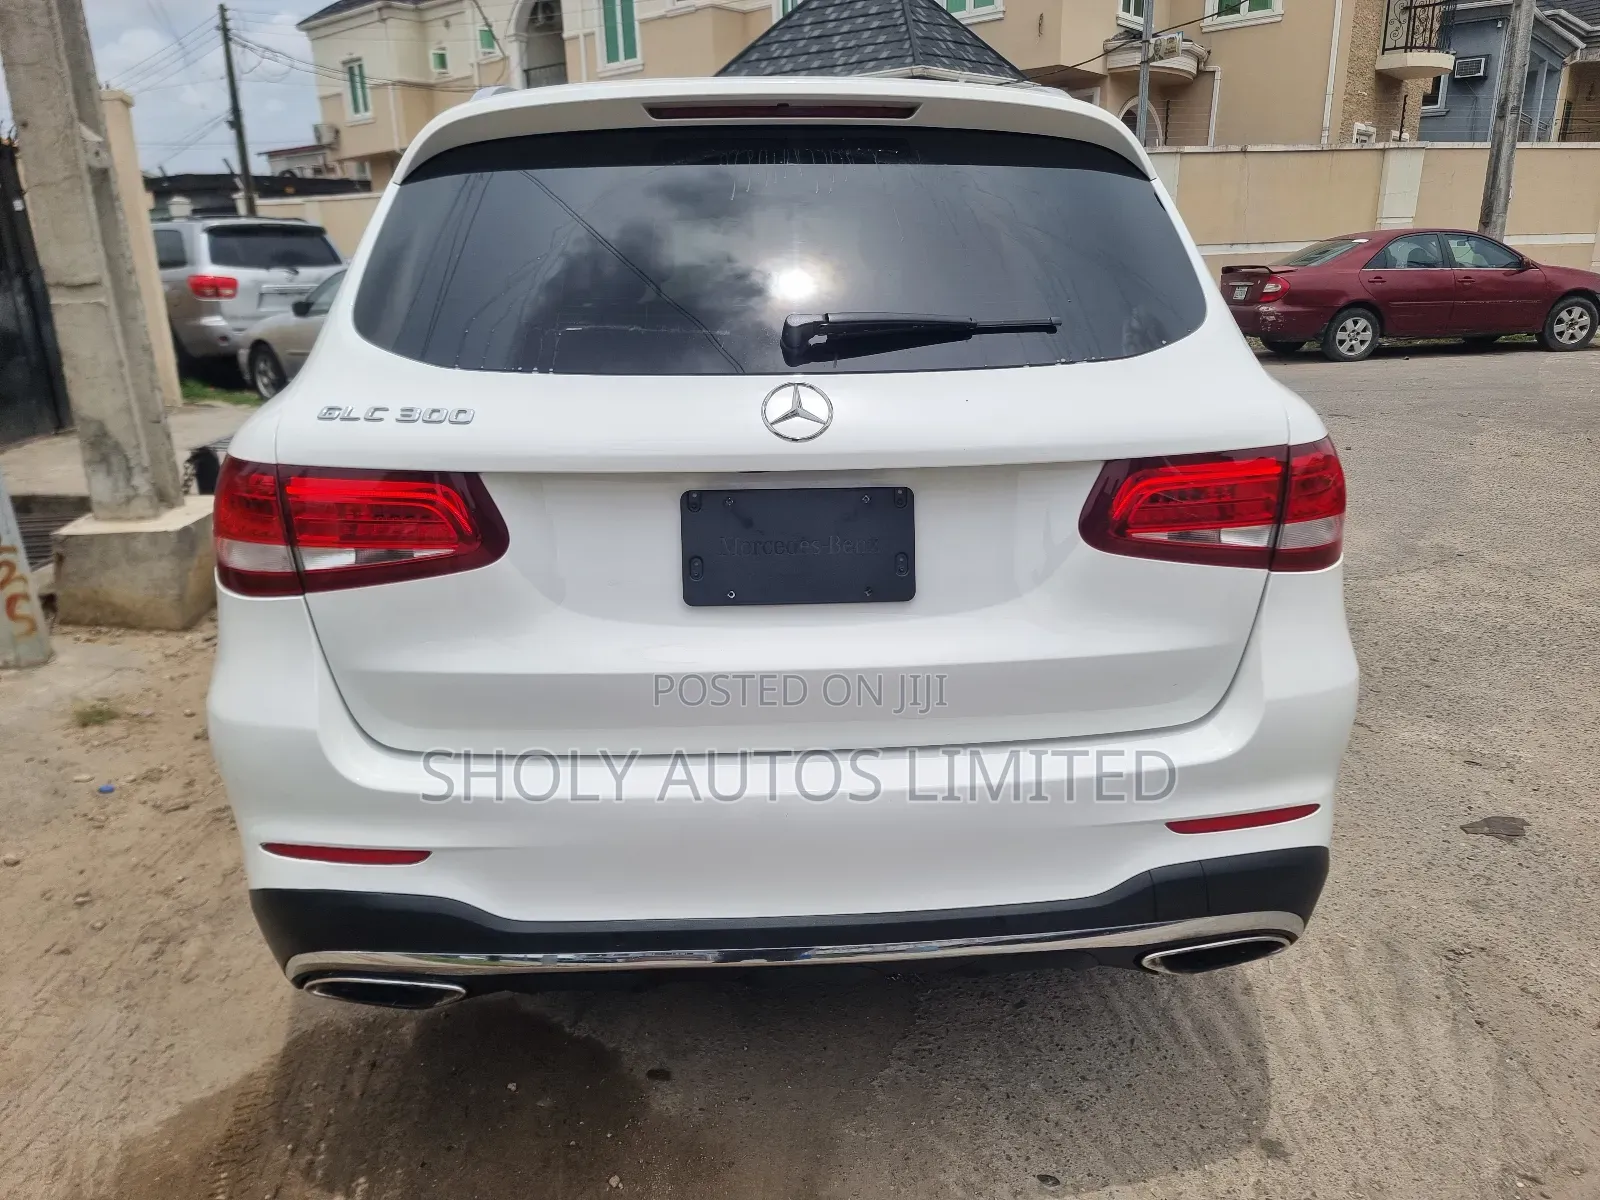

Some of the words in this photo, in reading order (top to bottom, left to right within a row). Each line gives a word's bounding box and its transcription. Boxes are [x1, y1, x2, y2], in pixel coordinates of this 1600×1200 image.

[317, 405, 389, 422] GLC
[395, 406, 476, 424] 300
[720, 535, 880, 556] Mercedes-Benz
